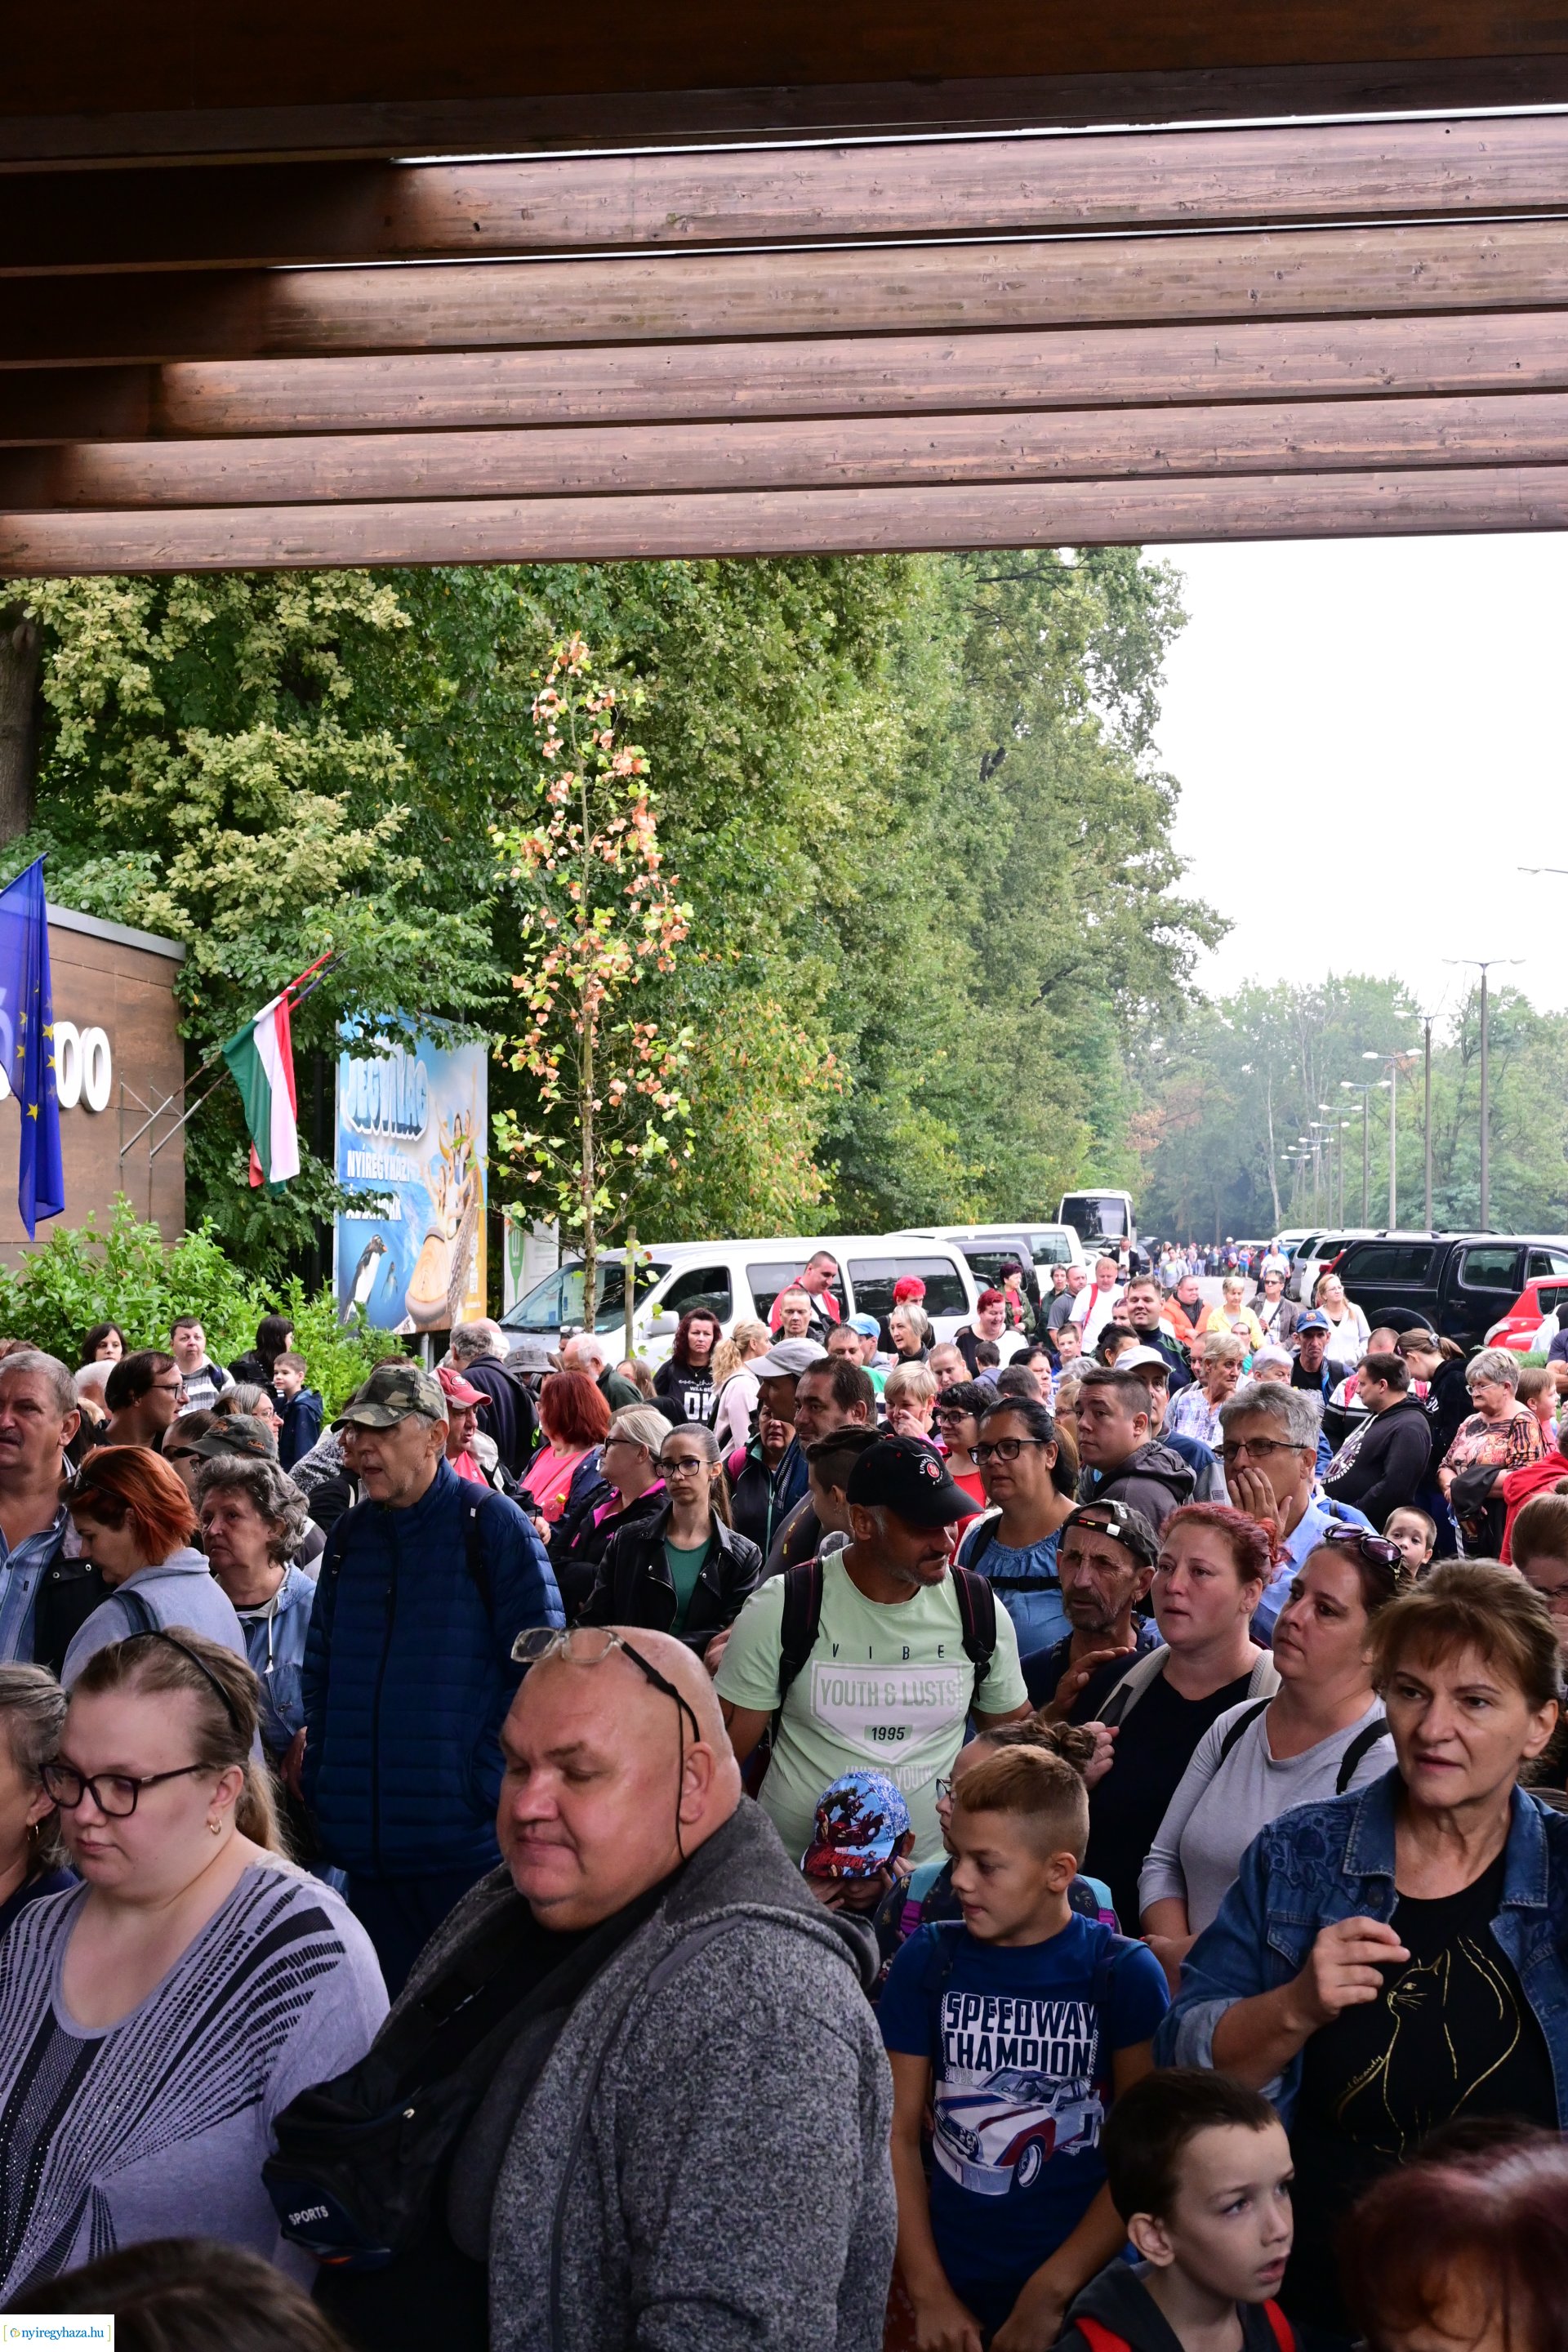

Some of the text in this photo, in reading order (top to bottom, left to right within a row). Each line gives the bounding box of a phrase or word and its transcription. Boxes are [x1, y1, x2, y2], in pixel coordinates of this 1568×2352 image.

[52, 1021, 112, 1111] OO
[821, 1678, 956, 1707] YOUTH & LUSTS
[871, 1726, 905, 1741] 1995
[946, 1992, 1098, 2039] SPEEDWAY
[945, 2031, 1091, 2077] CHAMPION
[288, 2205, 328, 2225] SPORTS
